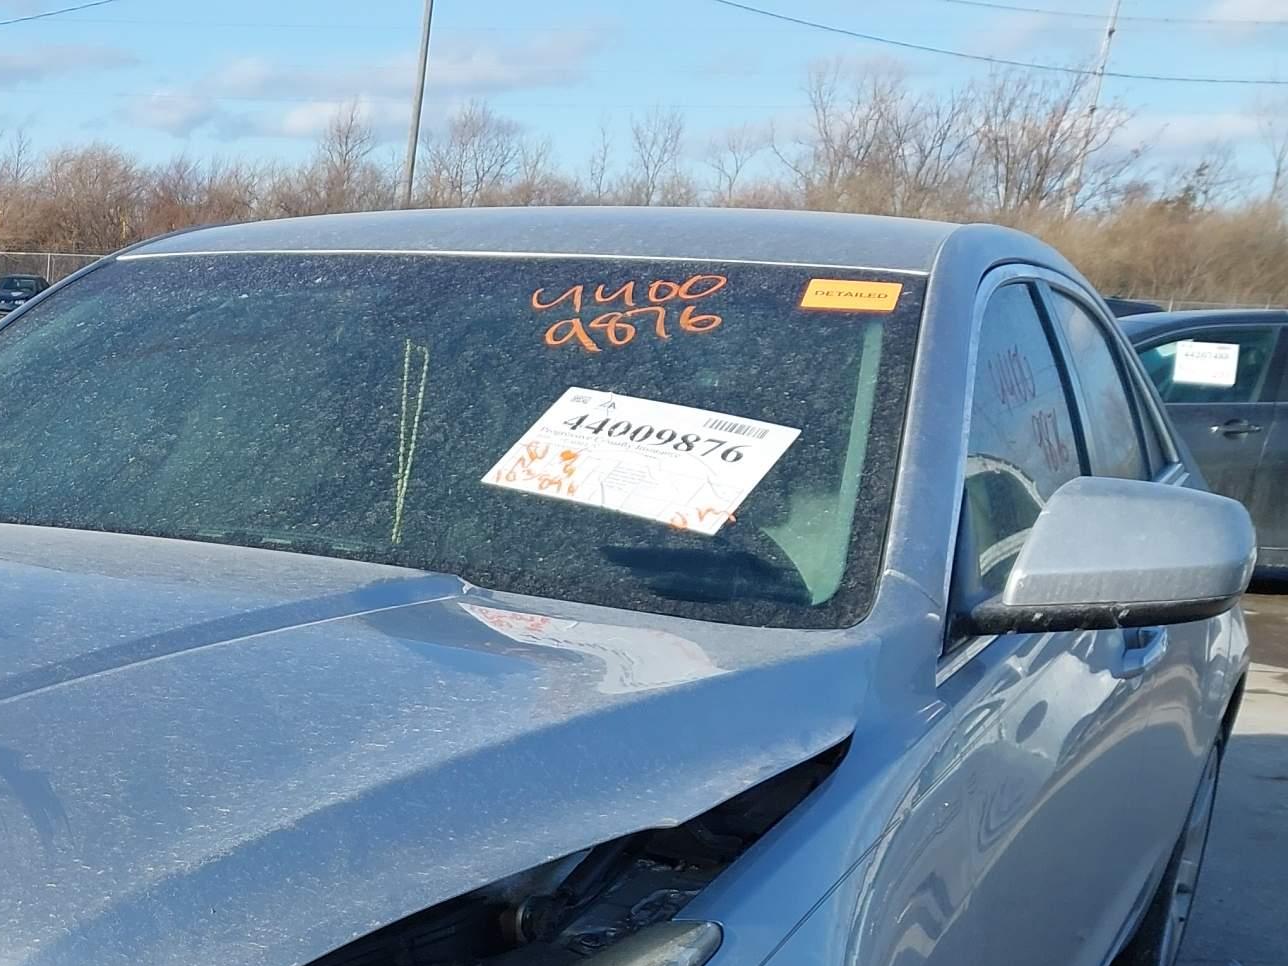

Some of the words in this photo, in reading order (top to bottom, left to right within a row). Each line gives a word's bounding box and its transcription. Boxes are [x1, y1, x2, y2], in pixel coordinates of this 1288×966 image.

[814, 289, 889, 300] DETAILED
[544, 305, 723, 352] 9876
[563, 413, 753, 463] 44009876
